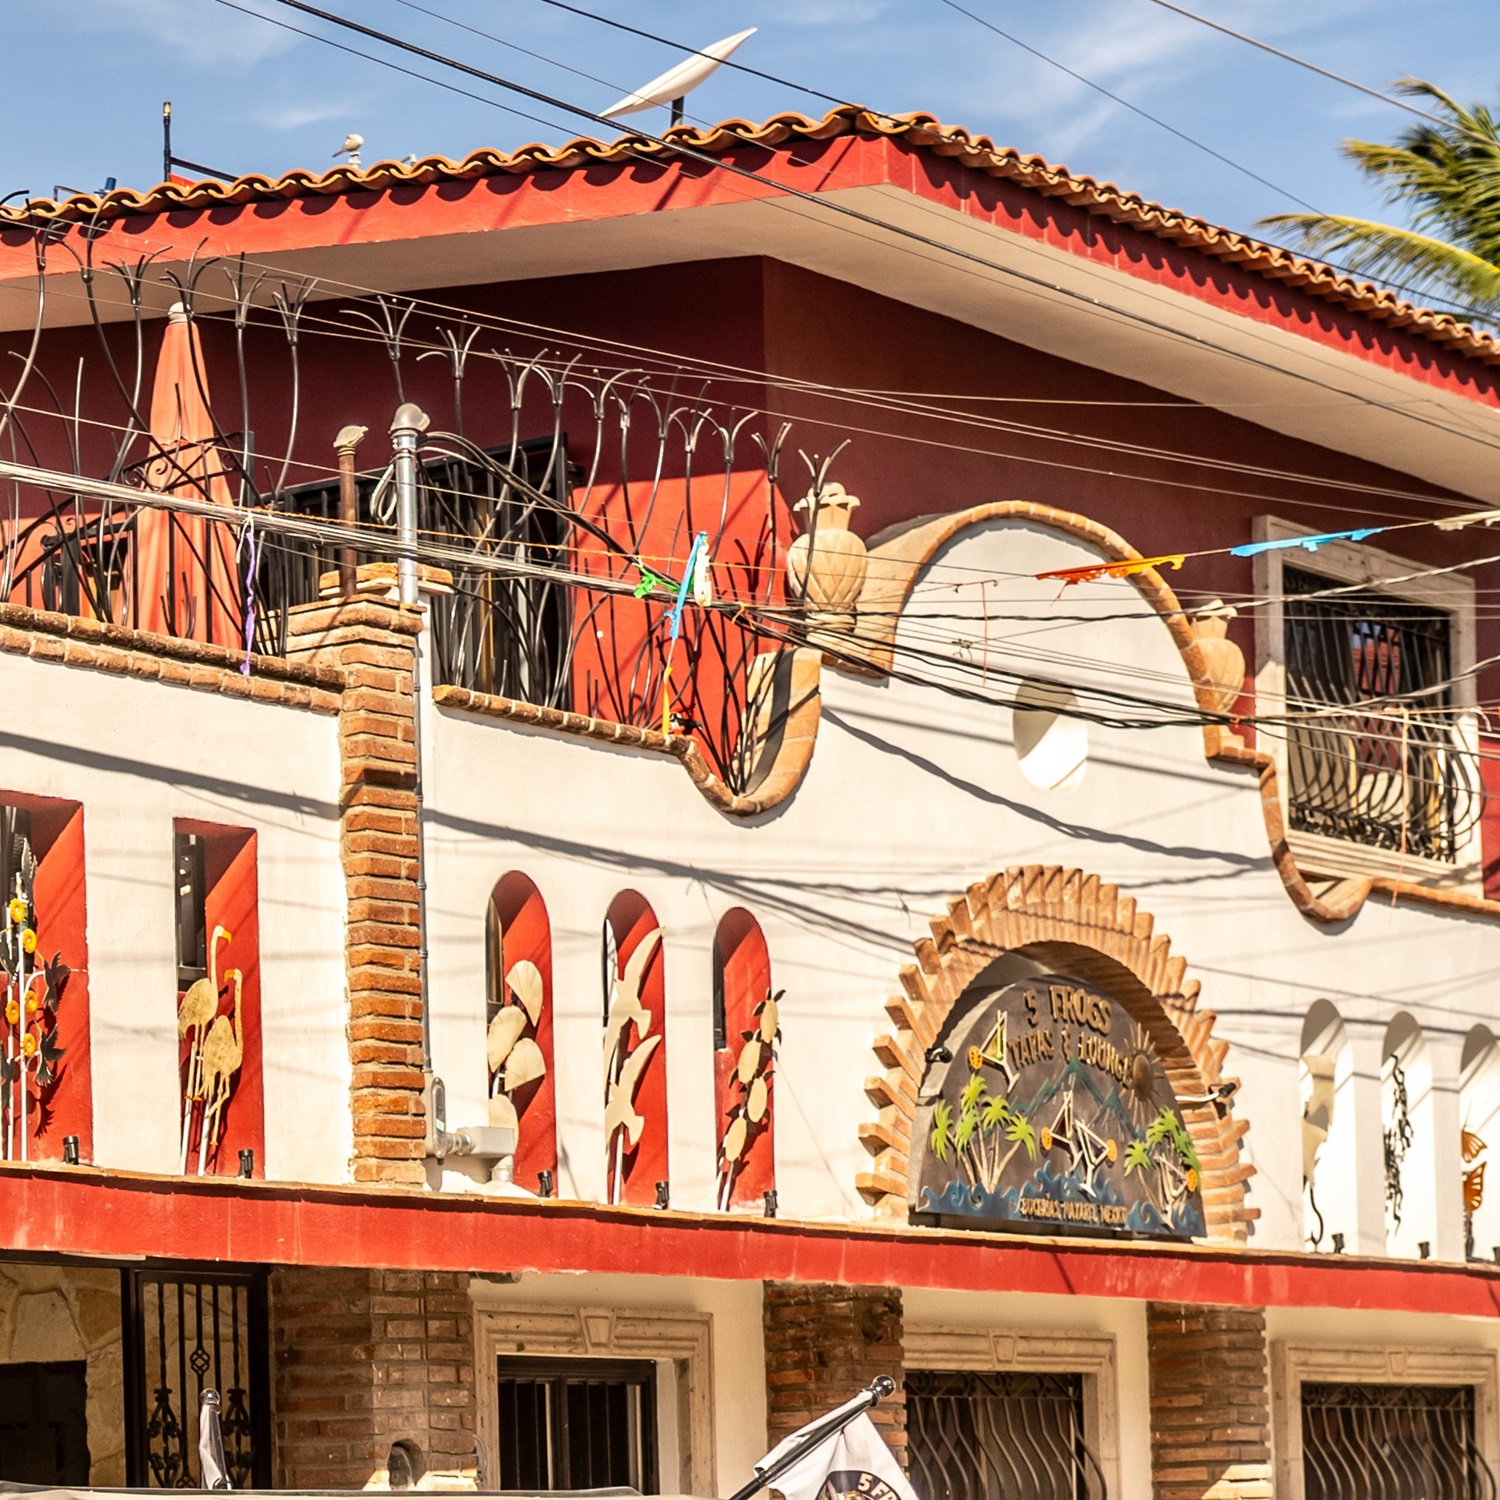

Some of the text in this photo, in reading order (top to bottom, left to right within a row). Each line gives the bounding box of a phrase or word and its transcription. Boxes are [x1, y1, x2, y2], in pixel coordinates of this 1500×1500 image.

[1024, 985, 1111, 1036] 5 FROGS
[858, 1473, 873, 1491] 5
